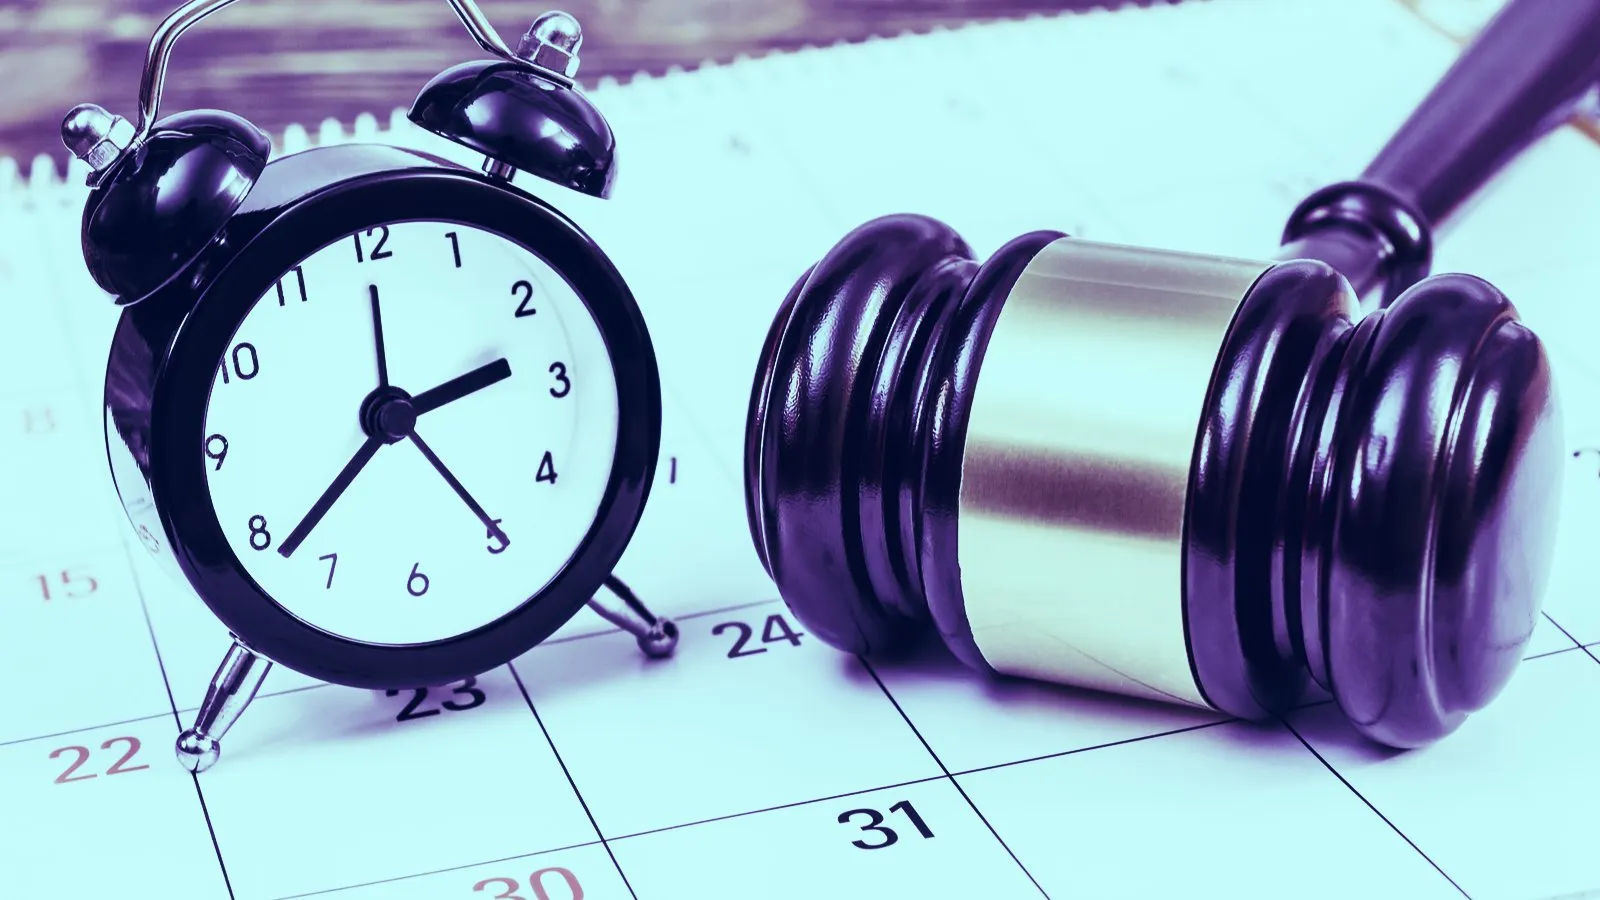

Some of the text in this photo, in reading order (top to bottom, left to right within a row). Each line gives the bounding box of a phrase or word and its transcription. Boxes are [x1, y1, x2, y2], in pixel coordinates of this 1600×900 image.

[352, 224, 393, 263] 12
[445, 232, 462, 268] 1
[275, 265, 308, 307] 11
[511, 280, 537, 318] 2
[220, 342, 260, 384] 10
[548, 361, 571, 398] 3
[205, 433, 229, 472] 9
[535, 451, 559, 485] 4
[248, 514, 272, 551] 8
[486, 518, 511, 554] 5
[34, 568, 99, 602] 15
[319, 553, 338, 589] 7
[406, 562, 430, 597] 6
[711, 613, 805, 659] 24
[385, 676, 487, 722] 23
[48, 735, 151, 785] 22
[837, 800, 936, 851] 31
[472, 866, 585, 900] 30
